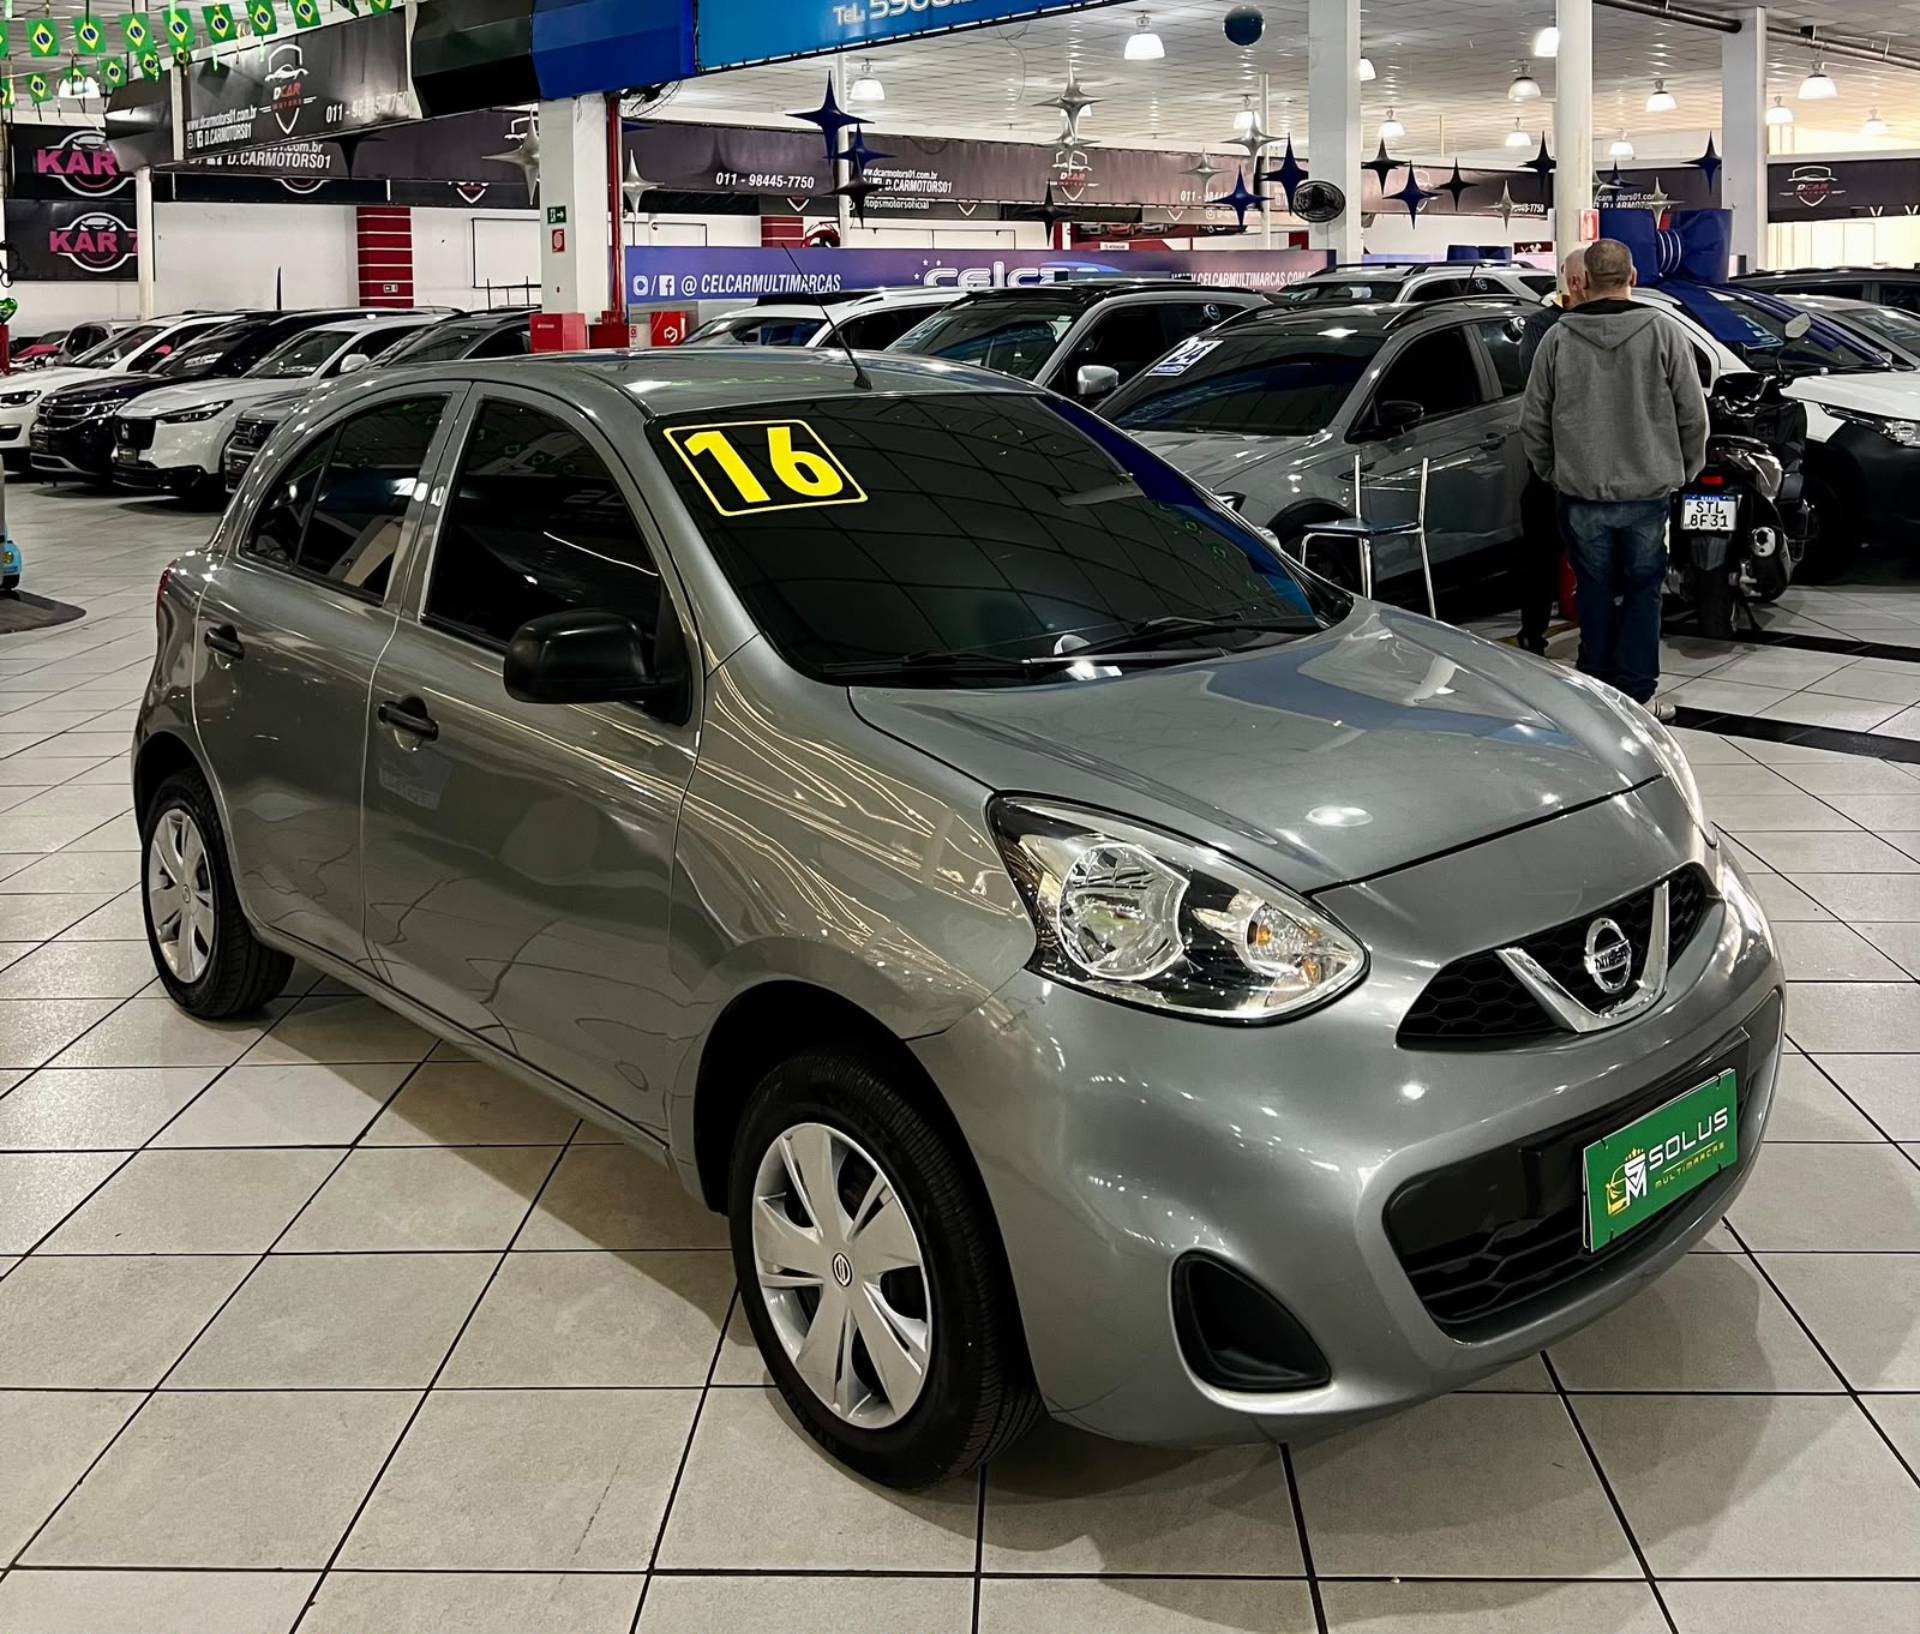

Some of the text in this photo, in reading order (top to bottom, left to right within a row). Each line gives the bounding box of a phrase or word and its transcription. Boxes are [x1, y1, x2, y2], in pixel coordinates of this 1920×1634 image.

[326, 103, 343, 123] 011
[37, 149, 117, 175] KAR
[227, 151, 331, 169] D.CARMOTORS01
[716, 172, 737, 186] 011
[749, 174, 815, 189] 98445-7750
[1180, 190, 1195, 202] 011
[49, 231, 119, 253] KAR
[701, 274, 841, 293] CELCARMULTIMARCAS
[684, 426, 843, 503] 16
[1696, 501, 1724, 514] STL
[1690, 514, 1729, 528] 8F31
[1649, 1107, 1728, 1171] SOLUS
[1655, 1141, 1725, 1190] MULTIMARCAS
